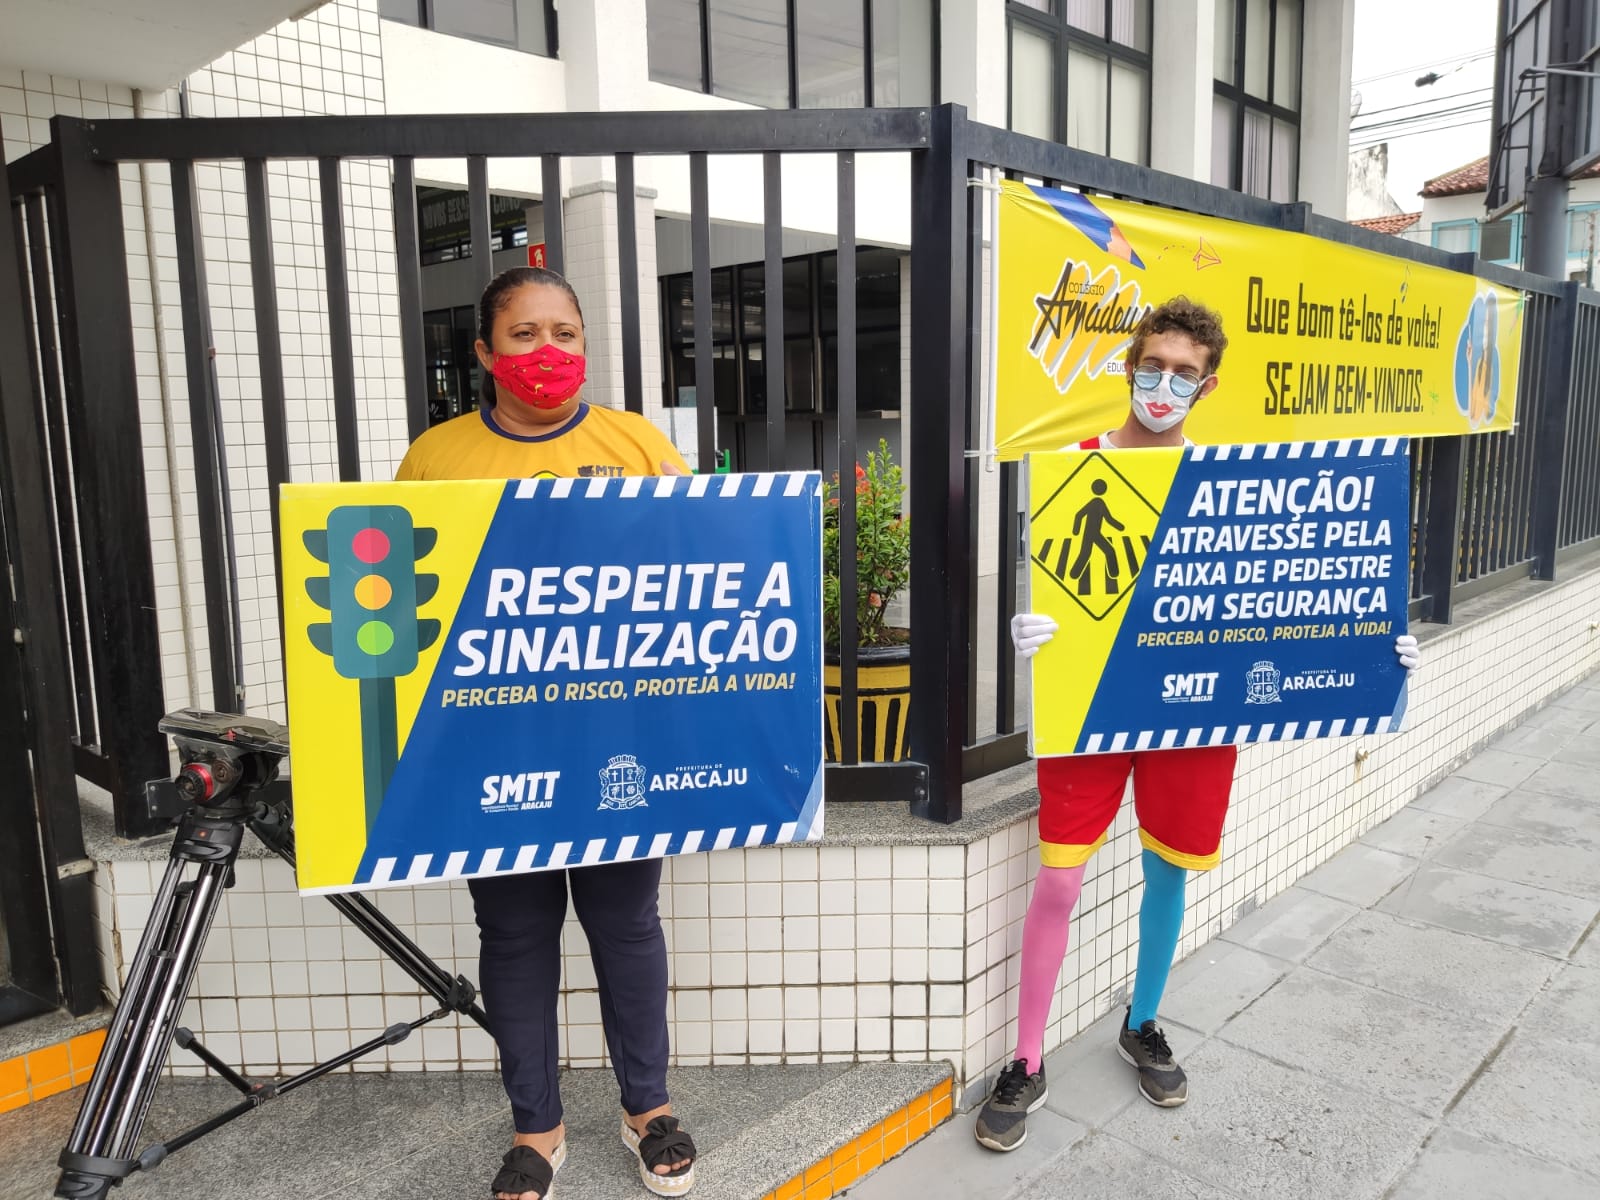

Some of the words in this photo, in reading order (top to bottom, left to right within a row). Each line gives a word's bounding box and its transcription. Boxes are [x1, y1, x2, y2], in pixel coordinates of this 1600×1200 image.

[1069, 281, 1105, 296] COLÉGIO
[1246, 276, 1290, 336] Que
[1296, 283, 1334, 339] bom
[1339, 294, 1383, 344] tê-los
[1387, 299, 1403, 346] de
[1408, 304, 1442, 349] volta!
[1265, 361, 1330, 416] SEJAM
[1333, 364, 1424, 414] BEM-VINDOS.
[1188, 469, 1376, 522] ATENÇÃO!
[1159, 522, 1318, 555] ATRAVESSE
[1324, 519, 1392, 549] PELA
[1153, 561, 1227, 588] FAIXA
[1234, 559, 1267, 585] DE
[1273, 554, 1393, 583] PEDESTRE
[485, 562, 747, 618] RESPEITE
[754, 561, 791, 608] A
[1152, 594, 1215, 624] COM
[1222, 586, 1388, 621] SEGURANÇA
[453, 609, 798, 677] SINALIZAÇÃO
[1136, 629, 1205, 647] PERCEBA
[1208, 629, 1220, 644] O
[1222, 625, 1268, 644] RISCO,
[1272, 623, 1336, 642] PROTEJA
[1338, 622, 1349, 637] A
[1354, 620, 1393, 637] VIDA!
[441, 683, 538, 708] PERCEBA
[544, 683, 560, 702] O
[565, 679, 628, 701] RISCO,
[634, 674, 720, 698] PROTEJA
[724, 674, 738, 692] A
[744, 672, 796, 691] VIDA!
[1161, 672, 1219, 698] SMTT
[1282, 672, 1355, 691] ARACAJU
[649, 767, 749, 792] ARACAJU
[675, 764, 713, 772] PREFEITURA
[480, 770, 561, 806] SMTT
[521, 800, 553, 811] ARACAJU
